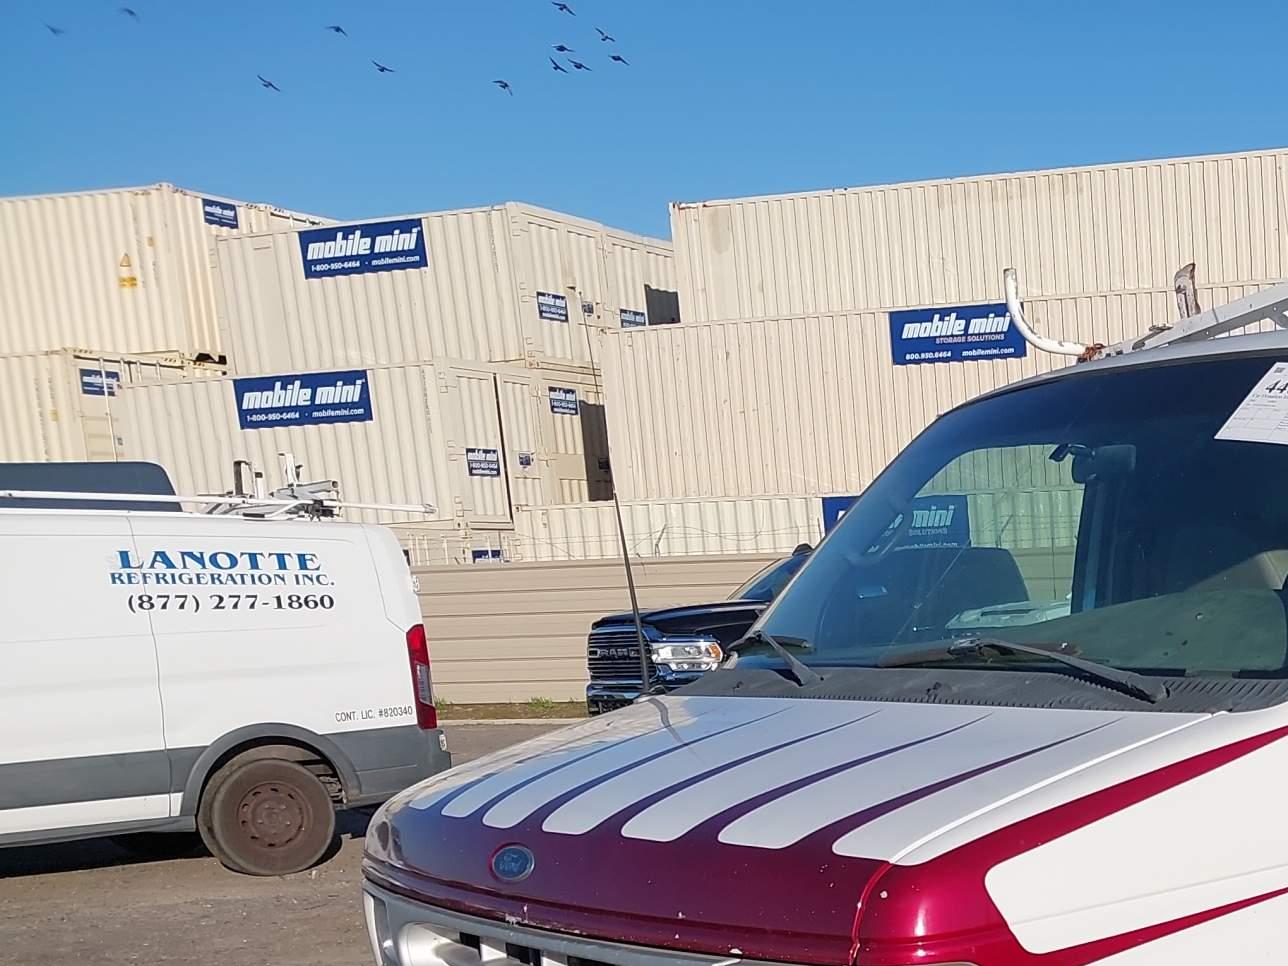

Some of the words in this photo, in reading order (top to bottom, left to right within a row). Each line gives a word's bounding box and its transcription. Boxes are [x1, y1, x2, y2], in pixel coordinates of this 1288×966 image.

[307, 230, 372, 261] mobile
[374, 227, 418, 254] mini
[371, 255, 420, 266] mobilemini.com
[902, 312, 966, 339] mobile
[968, 312, 1011, 335] mini
[935, 337, 966, 345] STORAGE
[966, 333, 1005, 342] SOLUTIONS
[962, 347, 1015, 357] mobilemini.com
[242, 380, 312, 410] mobile
[315, 379, 362, 405] mini
[312, 408, 365, 418] mobilemini.com
[117, 550, 321, 571] LANOTTE
[110, 572, 286, 586] REFRIGERATION
[295, 573, 335, 586] INC.
[128, 594, 200, 613] (877)
[209, 594, 335, 611] 277-1860
[335, 711, 359, 723] CONT.
[360, 709, 376, 720] LIC.
[378, 705, 413, 718] #820340
